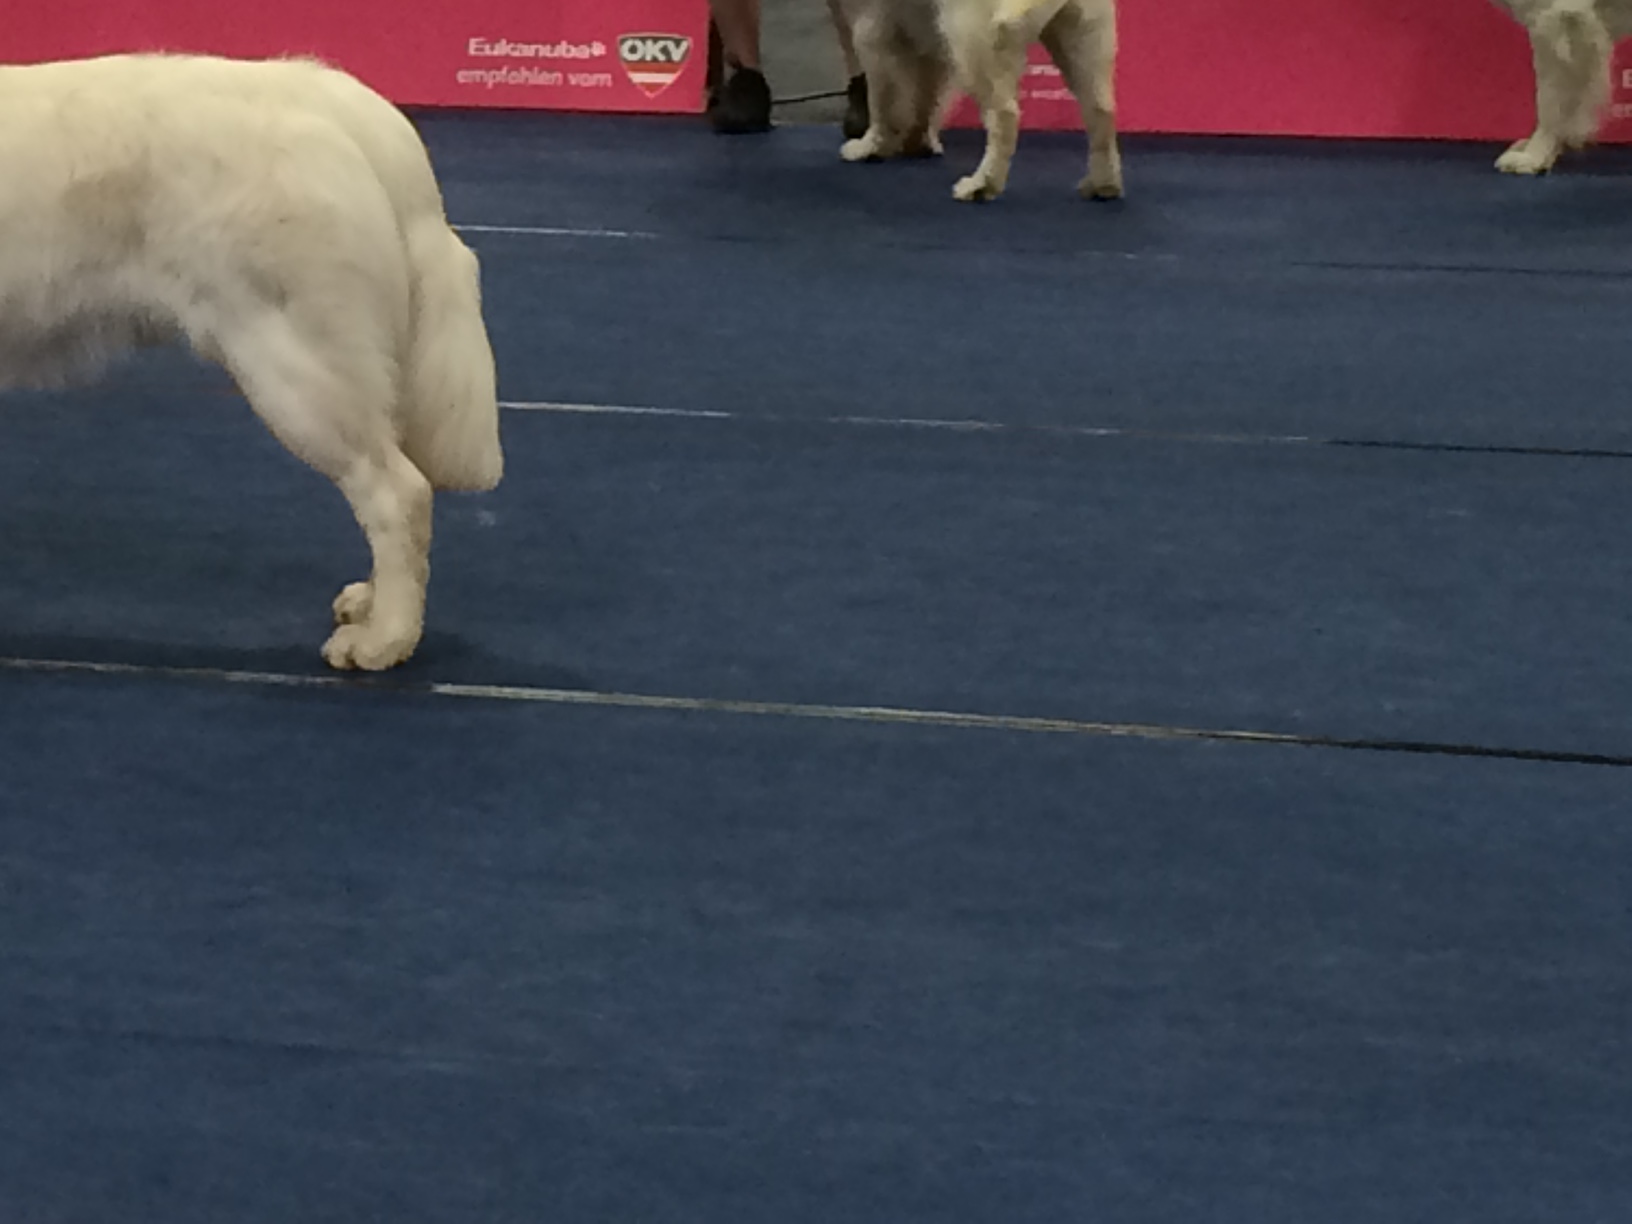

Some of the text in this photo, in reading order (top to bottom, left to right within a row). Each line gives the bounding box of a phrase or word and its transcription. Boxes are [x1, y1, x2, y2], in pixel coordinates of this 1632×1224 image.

[468, 37, 591, 60] Eukanuba
[455, 65, 613, 89] empfohlen vom
